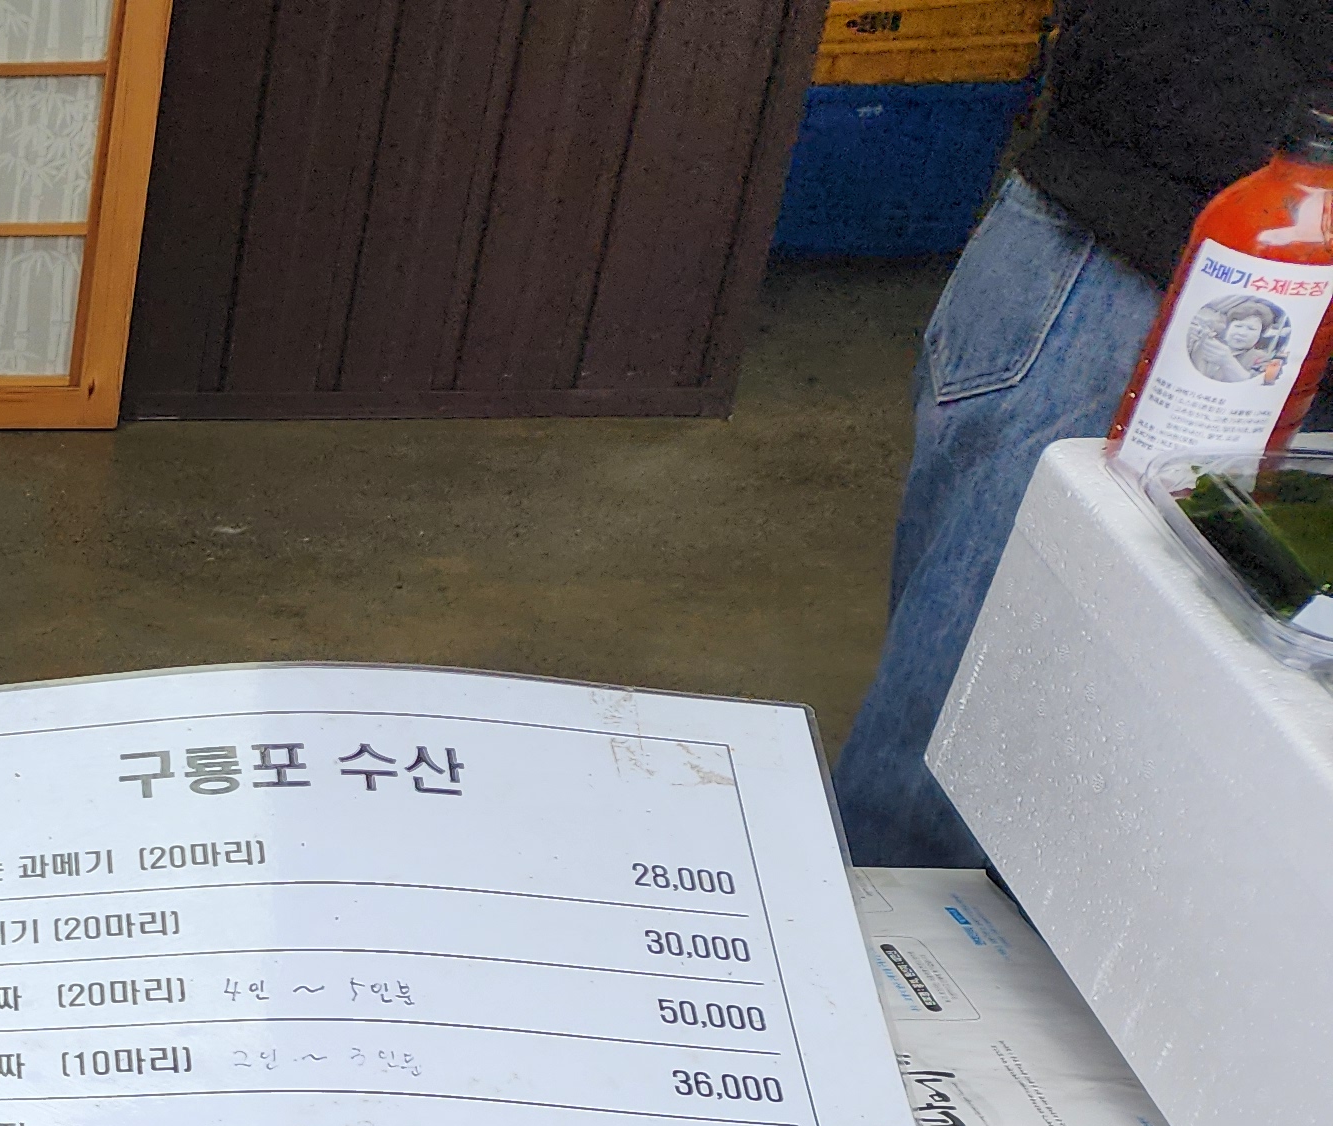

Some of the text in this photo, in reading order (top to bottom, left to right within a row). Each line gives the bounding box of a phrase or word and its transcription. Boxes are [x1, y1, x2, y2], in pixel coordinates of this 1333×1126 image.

[1200, 256, 1329, 297] 과메기수제초장
[118, 742, 464, 798] 구룡포 수산
[18, 849, 113, 880] 과메기
[631, 862, 735, 895] 28,000
[644, 929, 751, 963] 30,000
[658, 998, 767, 1032] 50,000
[672, 1069, 783, 1103] 36,000
